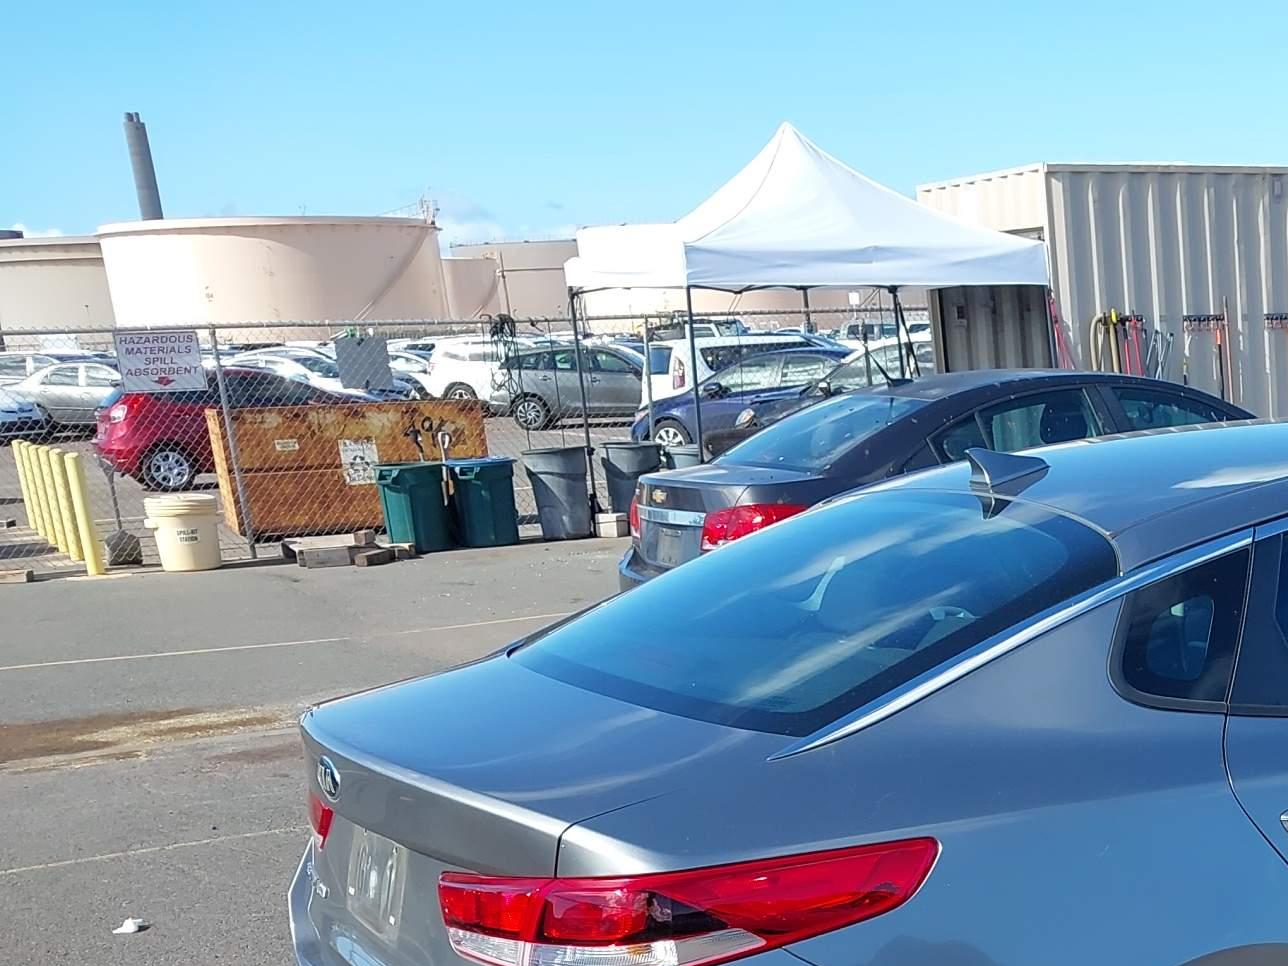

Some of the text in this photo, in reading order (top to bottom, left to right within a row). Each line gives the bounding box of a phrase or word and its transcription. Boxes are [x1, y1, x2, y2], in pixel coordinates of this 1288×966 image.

[119, 335, 193, 344] HAZARDOUS
[125, 345, 191, 355] MATERIALS
[144, 357, 177, 365] SPILL
[126, 366, 198, 377] ABSORBENT
